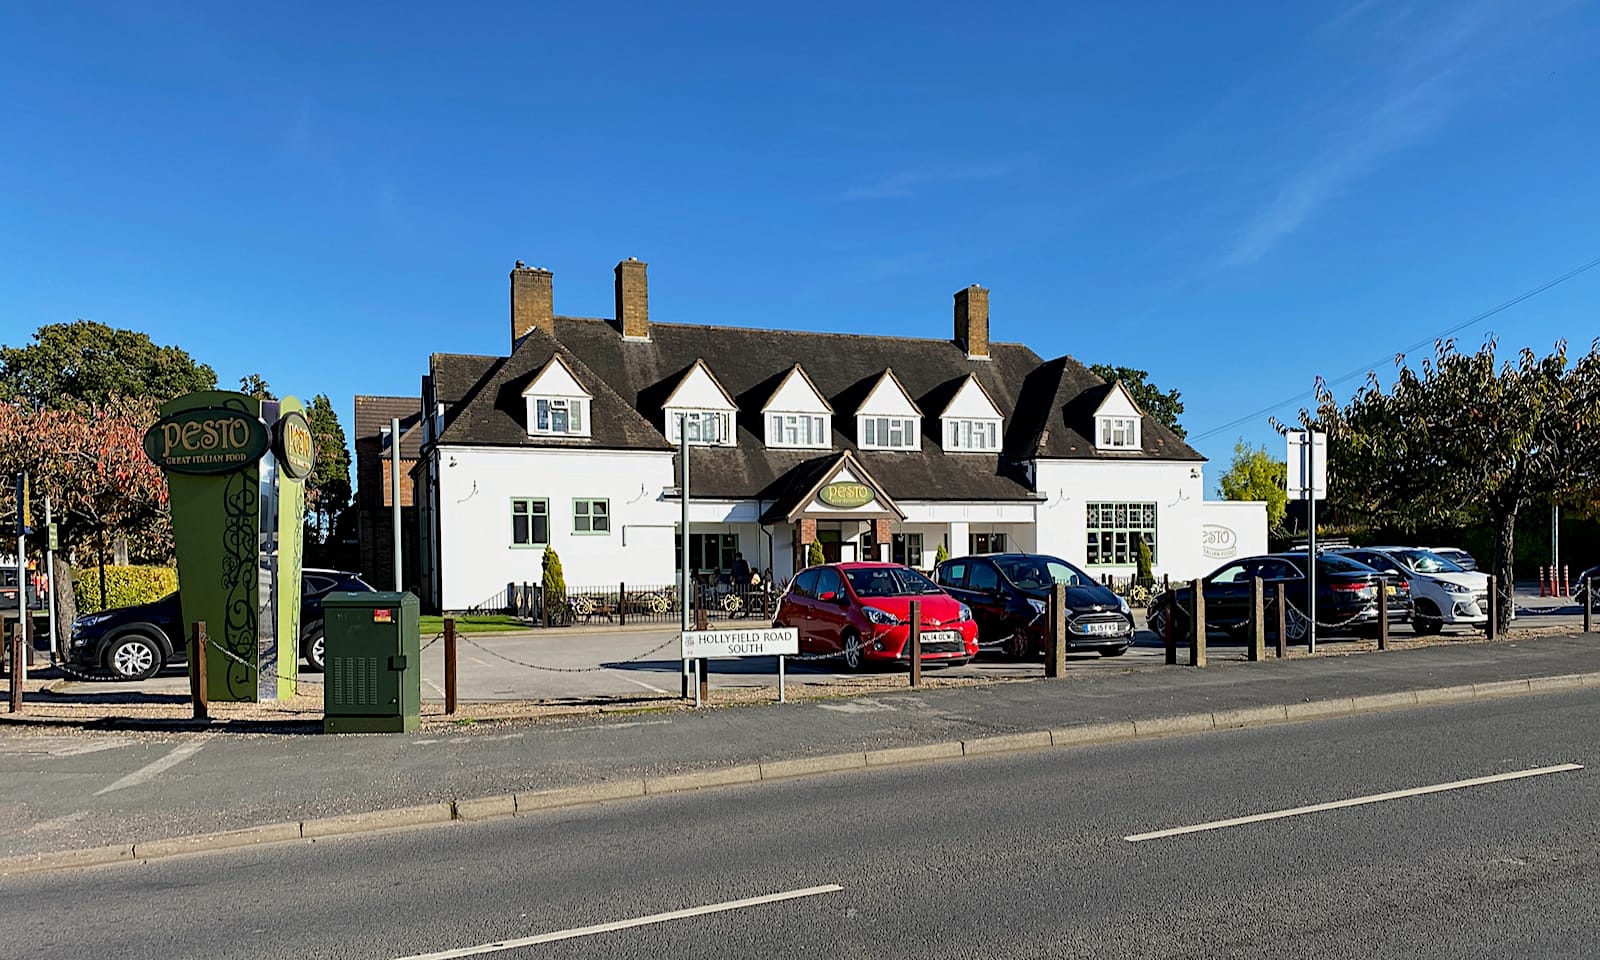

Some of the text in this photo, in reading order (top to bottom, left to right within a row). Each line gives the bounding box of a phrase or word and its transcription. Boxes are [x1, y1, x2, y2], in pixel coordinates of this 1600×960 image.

[161, 416, 249, 458] PESTO
[166, 453, 247, 465] GREAT ITALIAN FOOD
[698, 631, 792, 645] HOLLYFIELD ROAD
[728, 643, 763, 654] SOUTH
